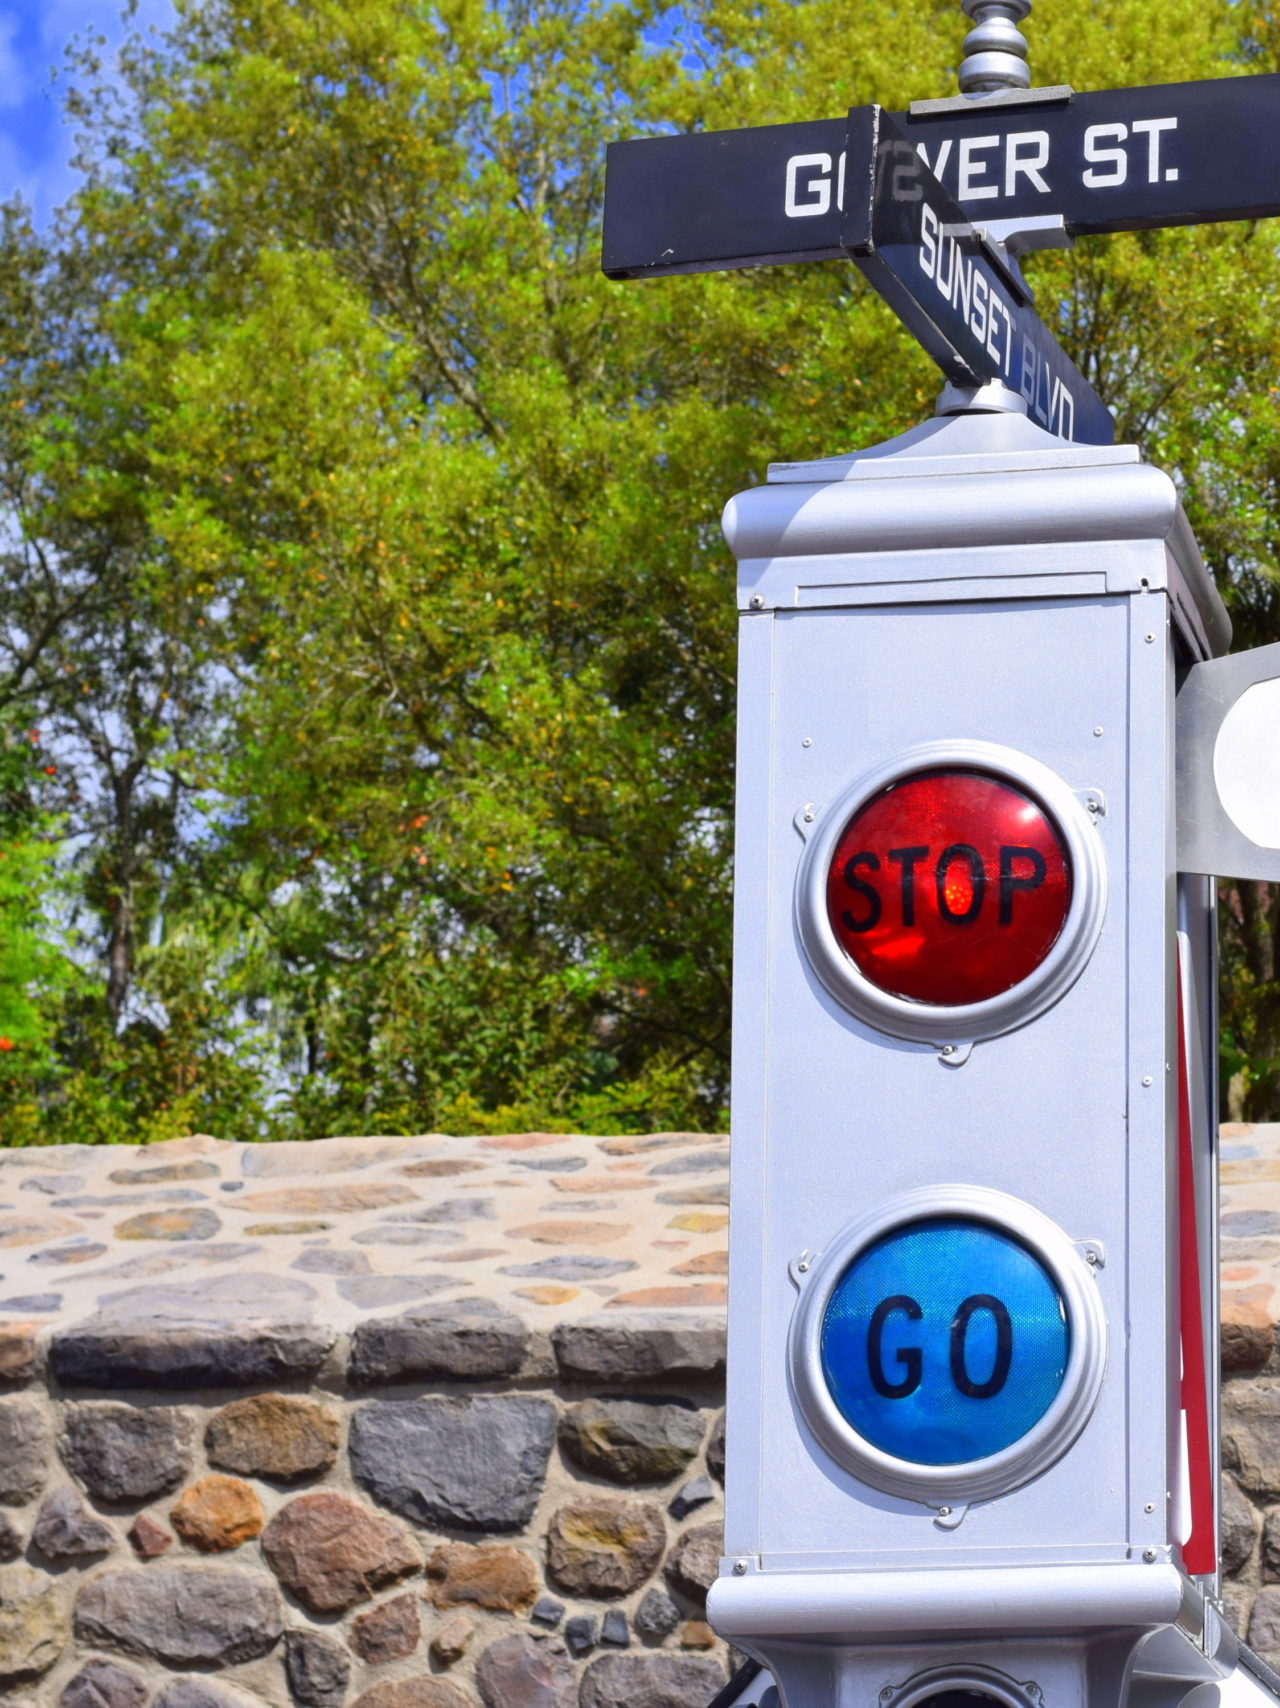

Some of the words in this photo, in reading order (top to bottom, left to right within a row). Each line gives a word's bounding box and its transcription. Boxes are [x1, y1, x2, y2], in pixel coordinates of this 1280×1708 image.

[785, 130, 1052, 218] GER
[1082, 117, 1178, 188] ST.
[919, 202, 1017, 377] SUNSET
[1020, 332, 1074, 442] BLVD
[841, 843, 1047, 933] STOP
[866, 1293, 1013, 1400] GO
